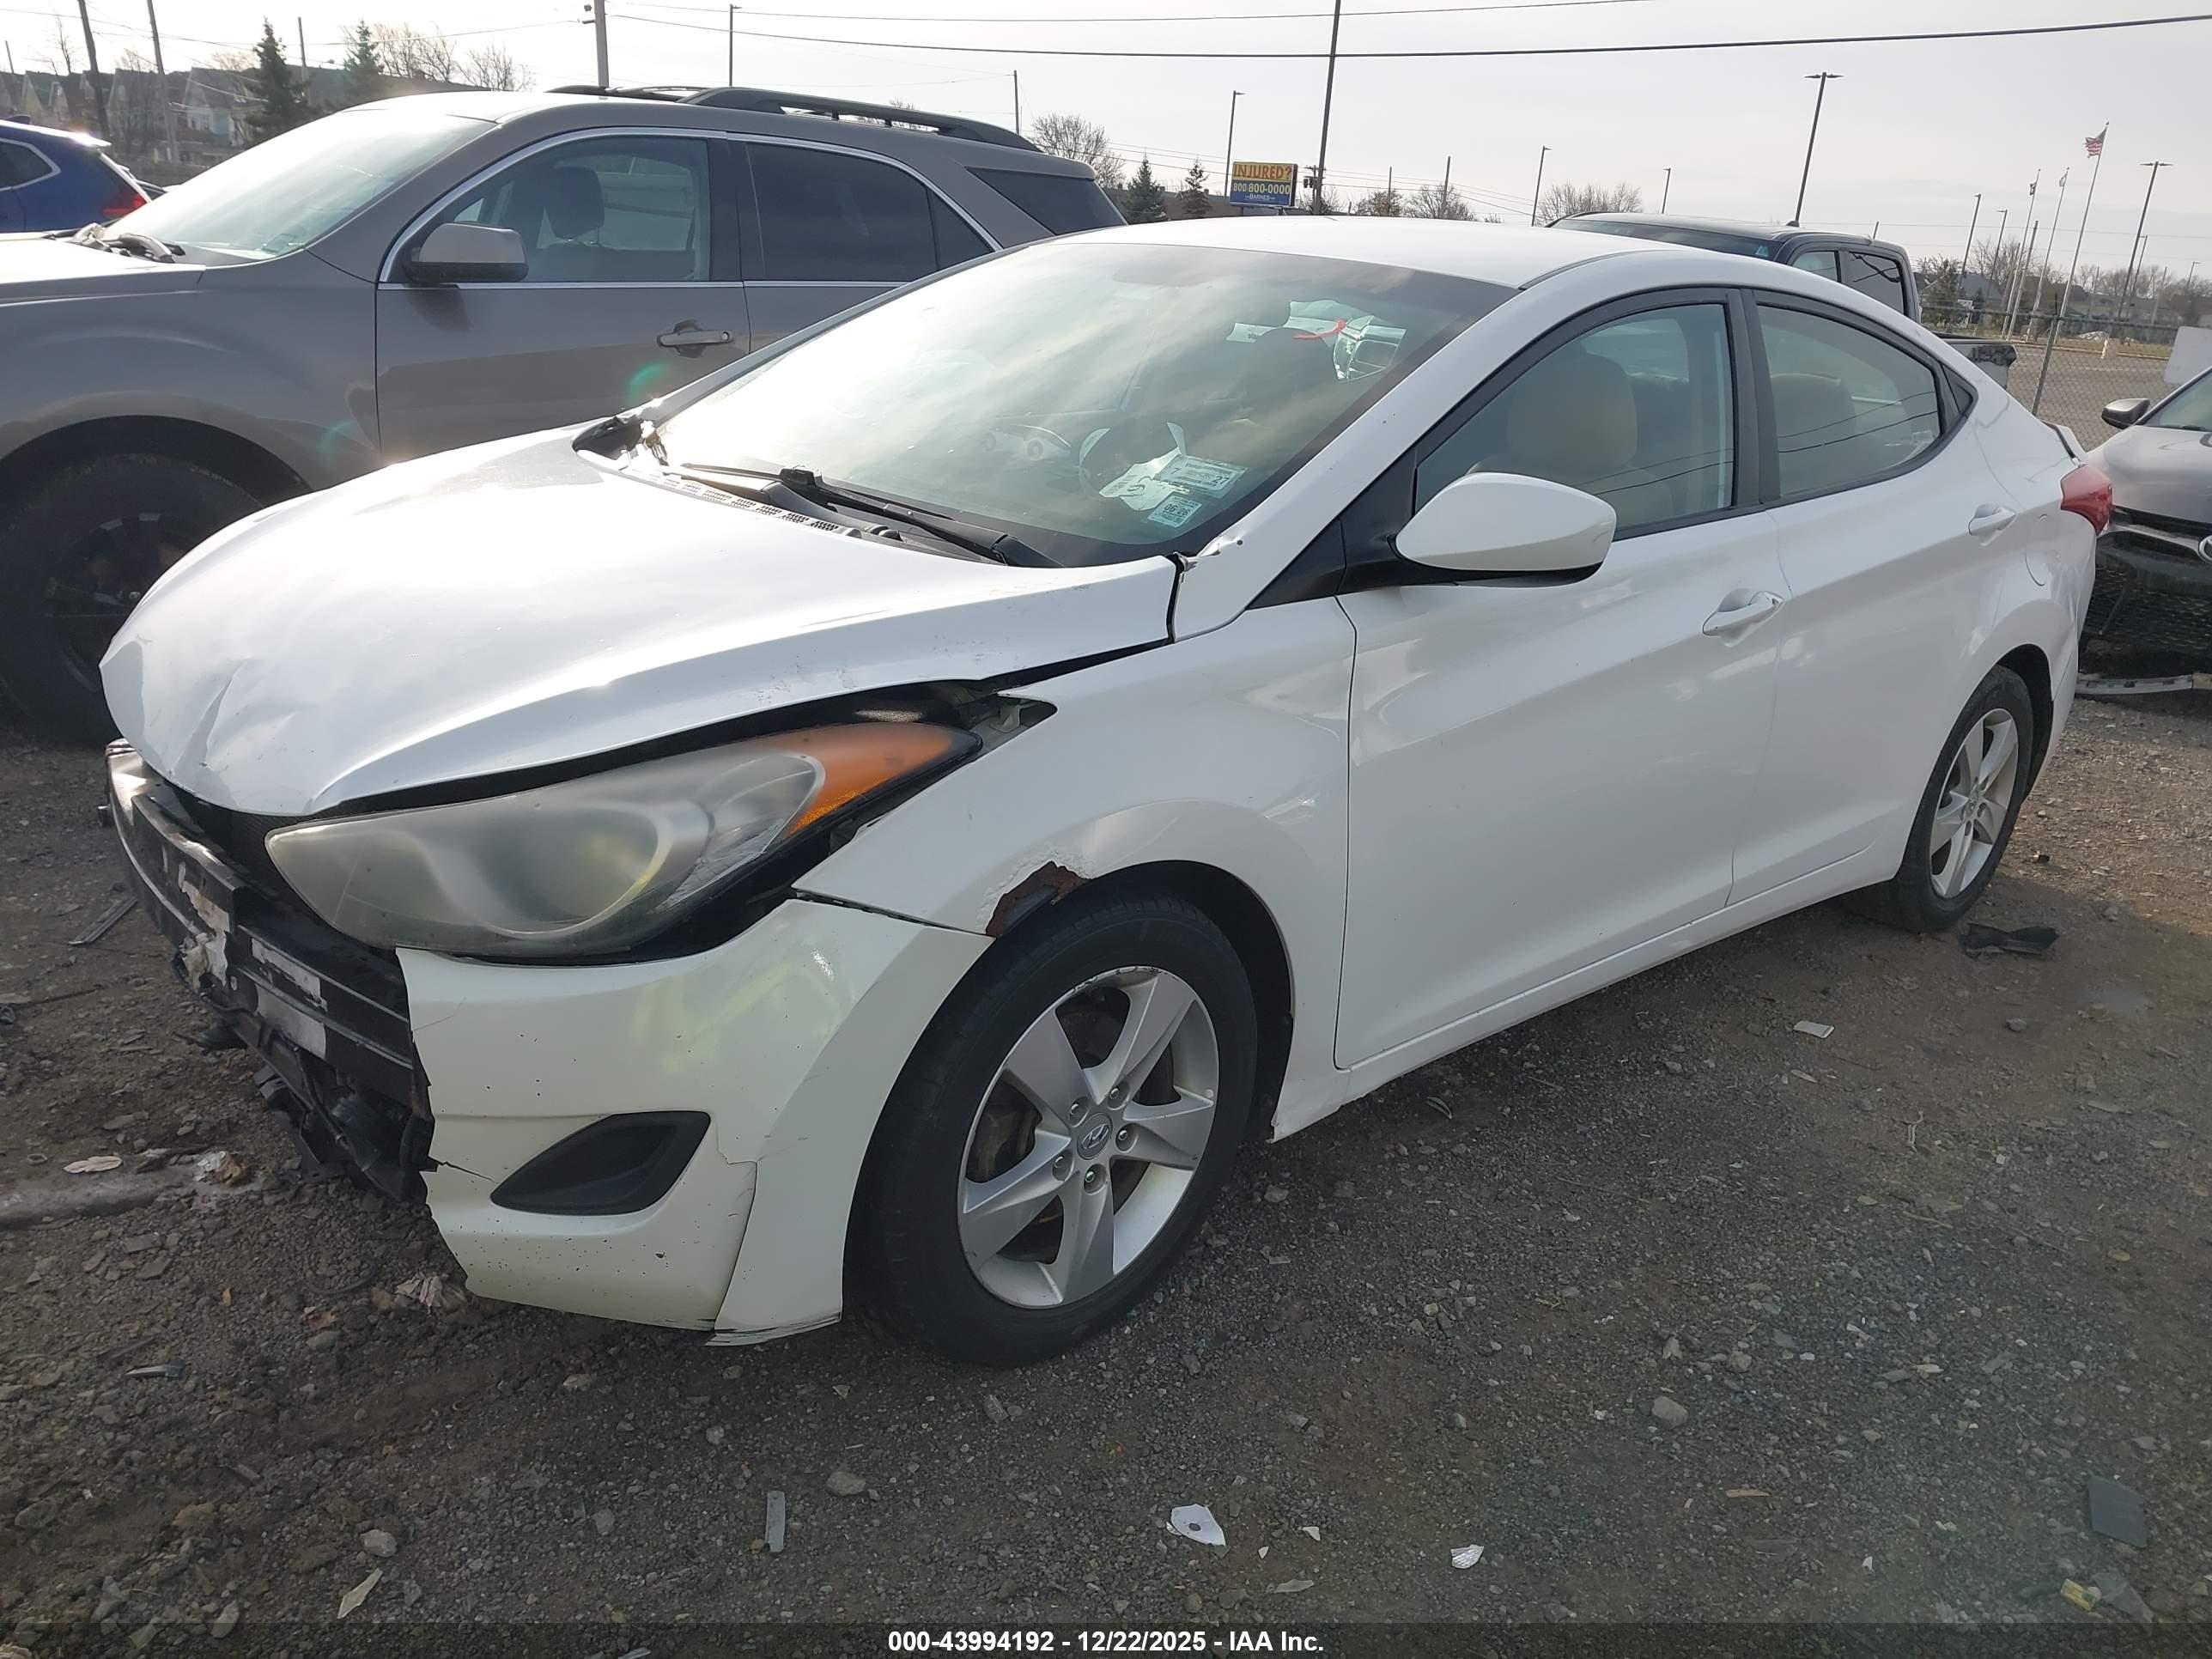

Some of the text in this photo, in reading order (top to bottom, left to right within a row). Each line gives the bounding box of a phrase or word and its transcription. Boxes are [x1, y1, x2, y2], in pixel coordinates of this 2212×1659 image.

[1233, 164, 1292, 179] INJURED?
[1233, 183, 1291, 194] 800 800-0000
[1212, 475, 1230, 485] 27
